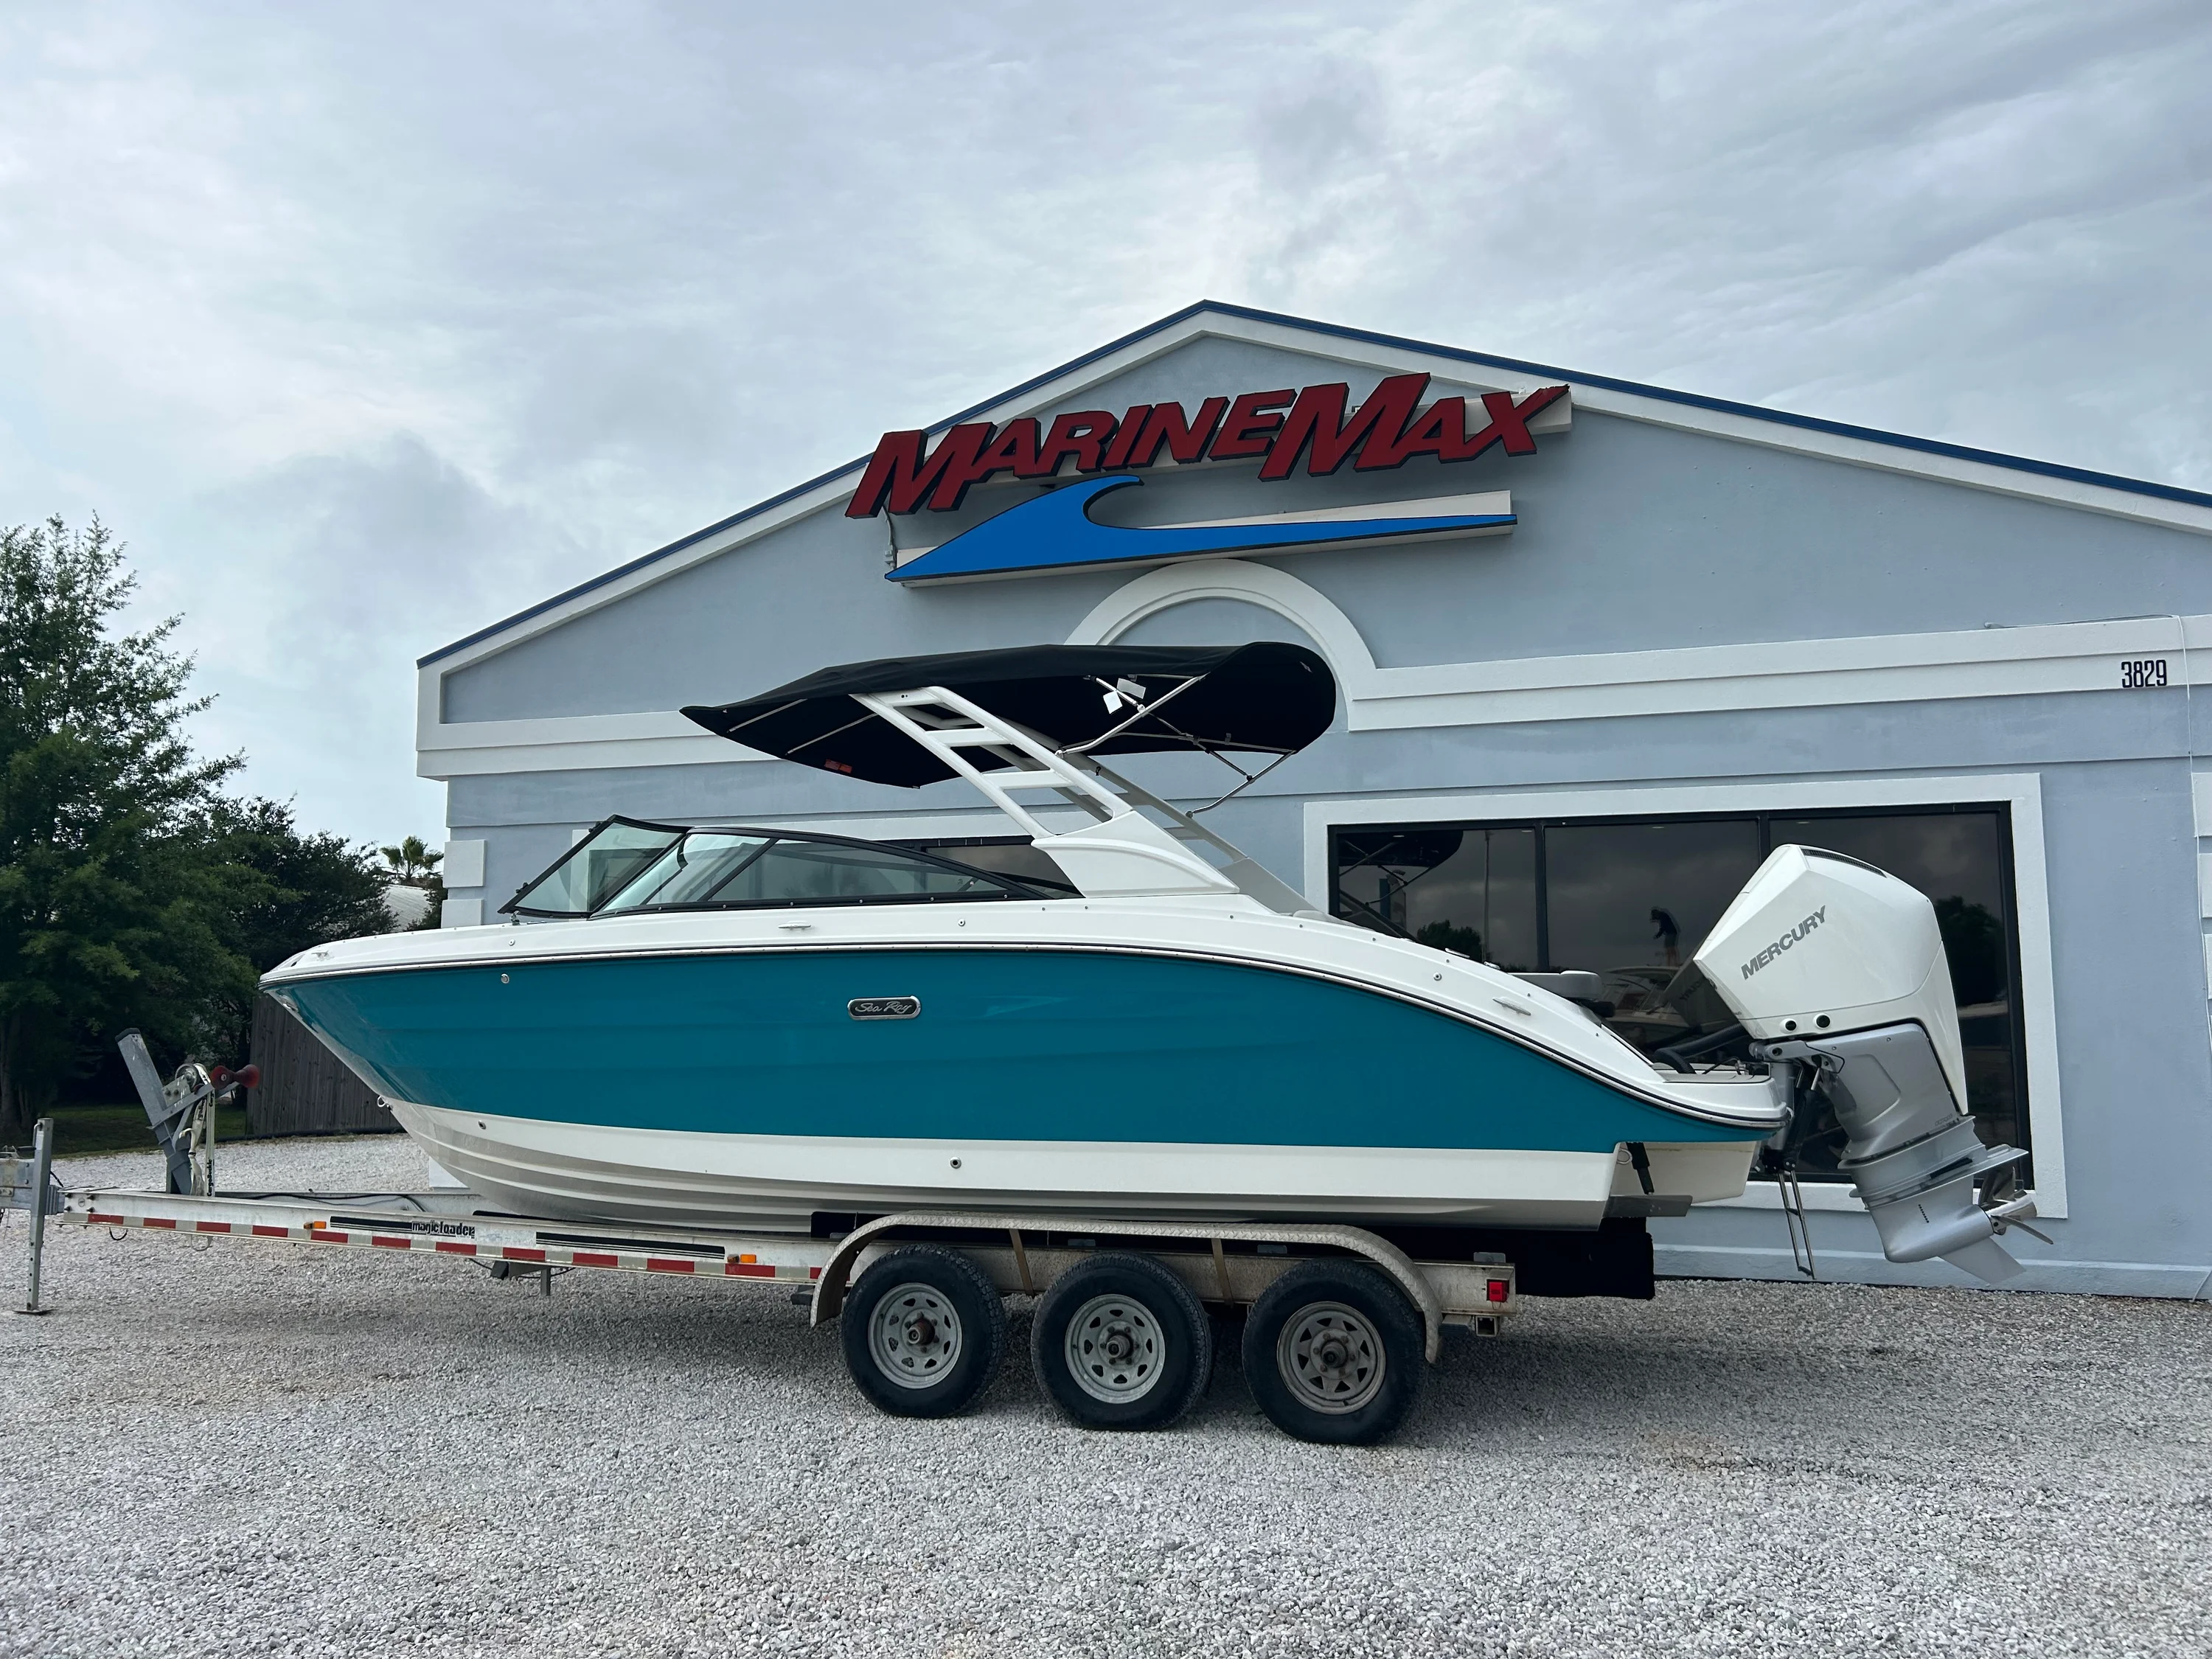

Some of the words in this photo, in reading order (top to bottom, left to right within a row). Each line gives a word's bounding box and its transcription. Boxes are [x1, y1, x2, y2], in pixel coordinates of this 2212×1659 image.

[2121, 659, 2167, 688] 3829
[1741, 905, 1826, 981] MERCURY
[855, 1002, 882, 1012] Sea
[883, 1001, 912, 1014] Ray
